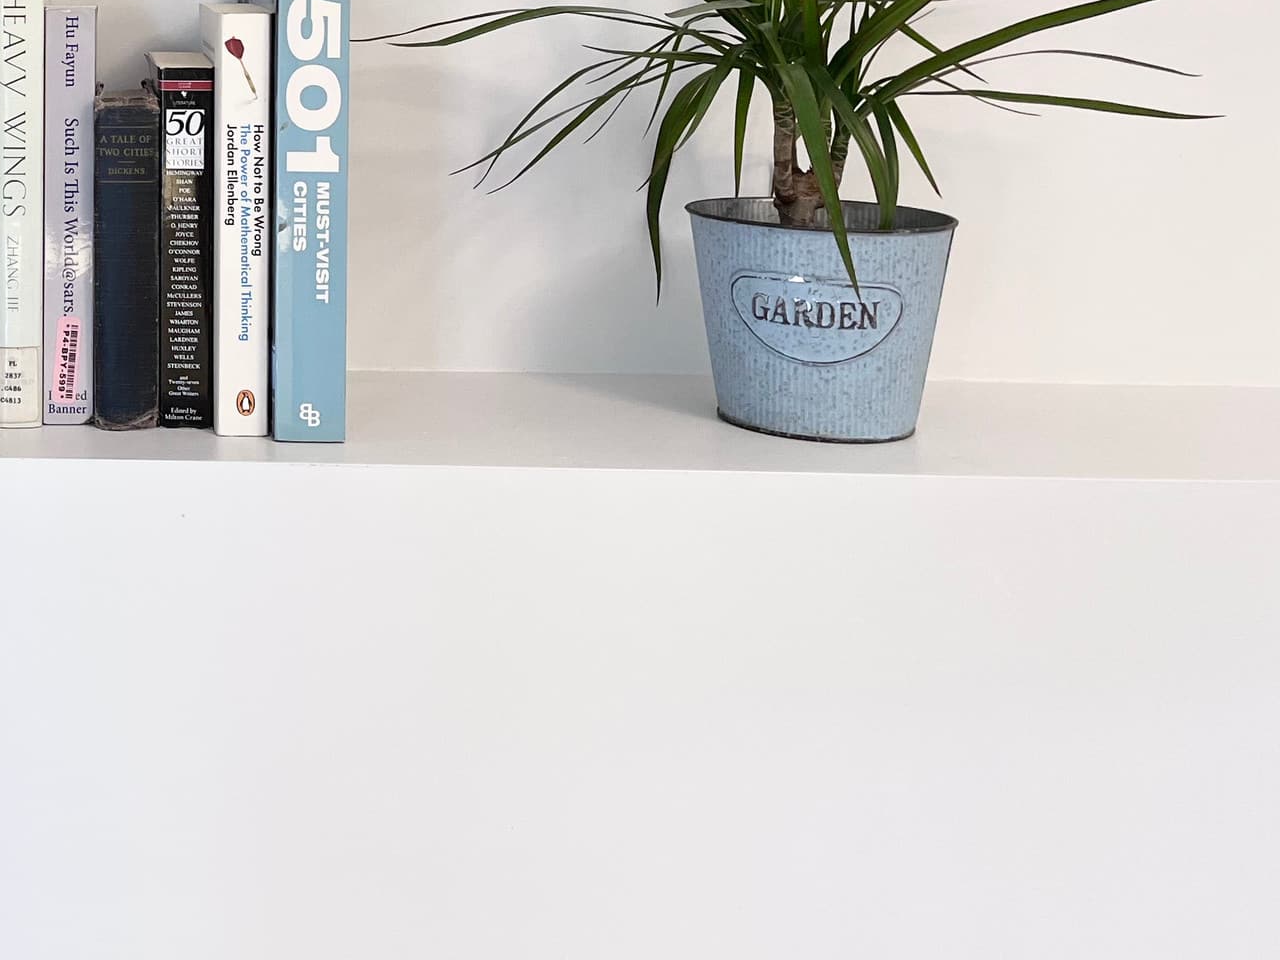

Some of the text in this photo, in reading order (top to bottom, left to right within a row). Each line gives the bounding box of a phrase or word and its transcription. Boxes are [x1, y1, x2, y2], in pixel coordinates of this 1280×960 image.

[61, 16, 79, 88] Hu Fayun
[64, 118, 80, 156] Such
[100, 135, 152, 144] A TALE OF
[164, 110, 206, 136] 50
[2, 112, 26, 216] WINGS
[64, 162, 79, 174] Is
[97, 148, 154, 157] TWO CITIES
[166, 158, 204, 167] STORIES
[224, 124, 239, 226] Jordan Ellenberg
[251, 124, 265, 256] How Not to Be Wrong
[64, 178, 80, 213] This
[238, 124, 253, 342] The Power of Mathematical Thinking
[293, 181, 308, 252] CITIES
[315, 182, 330, 304] MUST-VISIT
[6, 235, 20, 290] ZHANG
[751, 292, 881, 330] GARDEN
[48, 404, 88, 414] Banner
